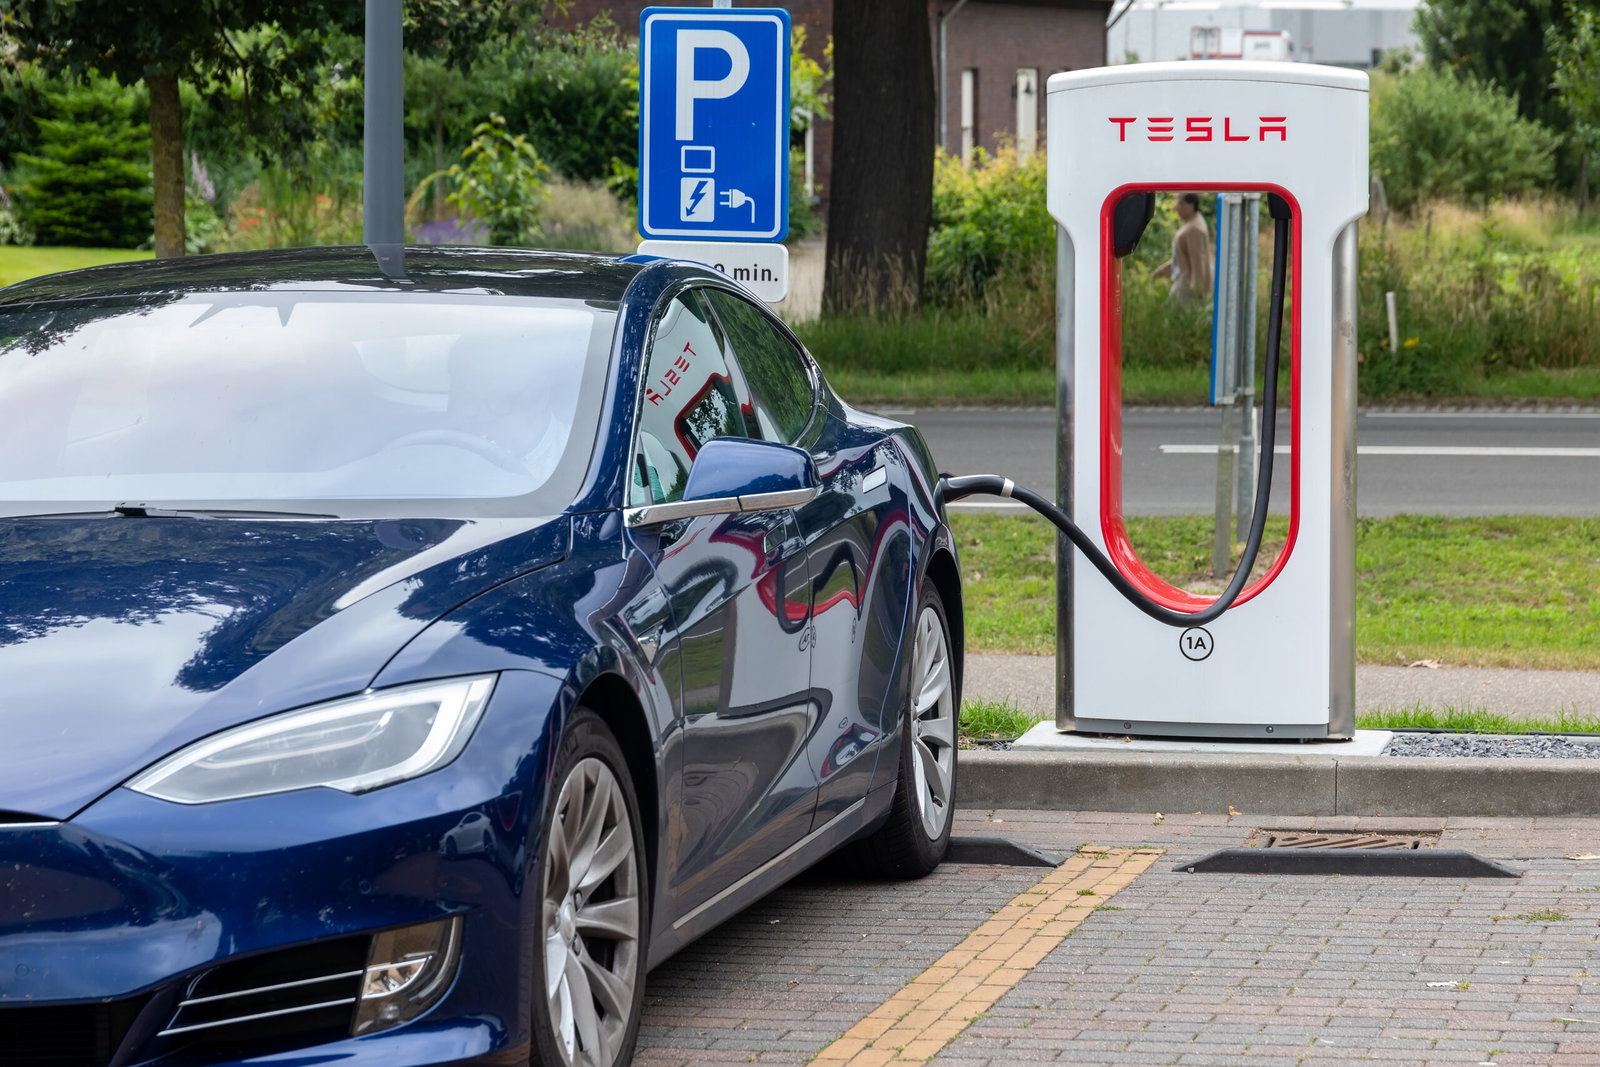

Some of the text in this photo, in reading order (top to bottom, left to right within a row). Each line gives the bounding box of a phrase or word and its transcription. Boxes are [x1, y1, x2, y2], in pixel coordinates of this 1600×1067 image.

[675, 29, 750, 141] P
[1108, 117, 1287, 142] TESLA
[733, 263, 779, 282] min.
[1186, 636, 1207, 650] 1A
